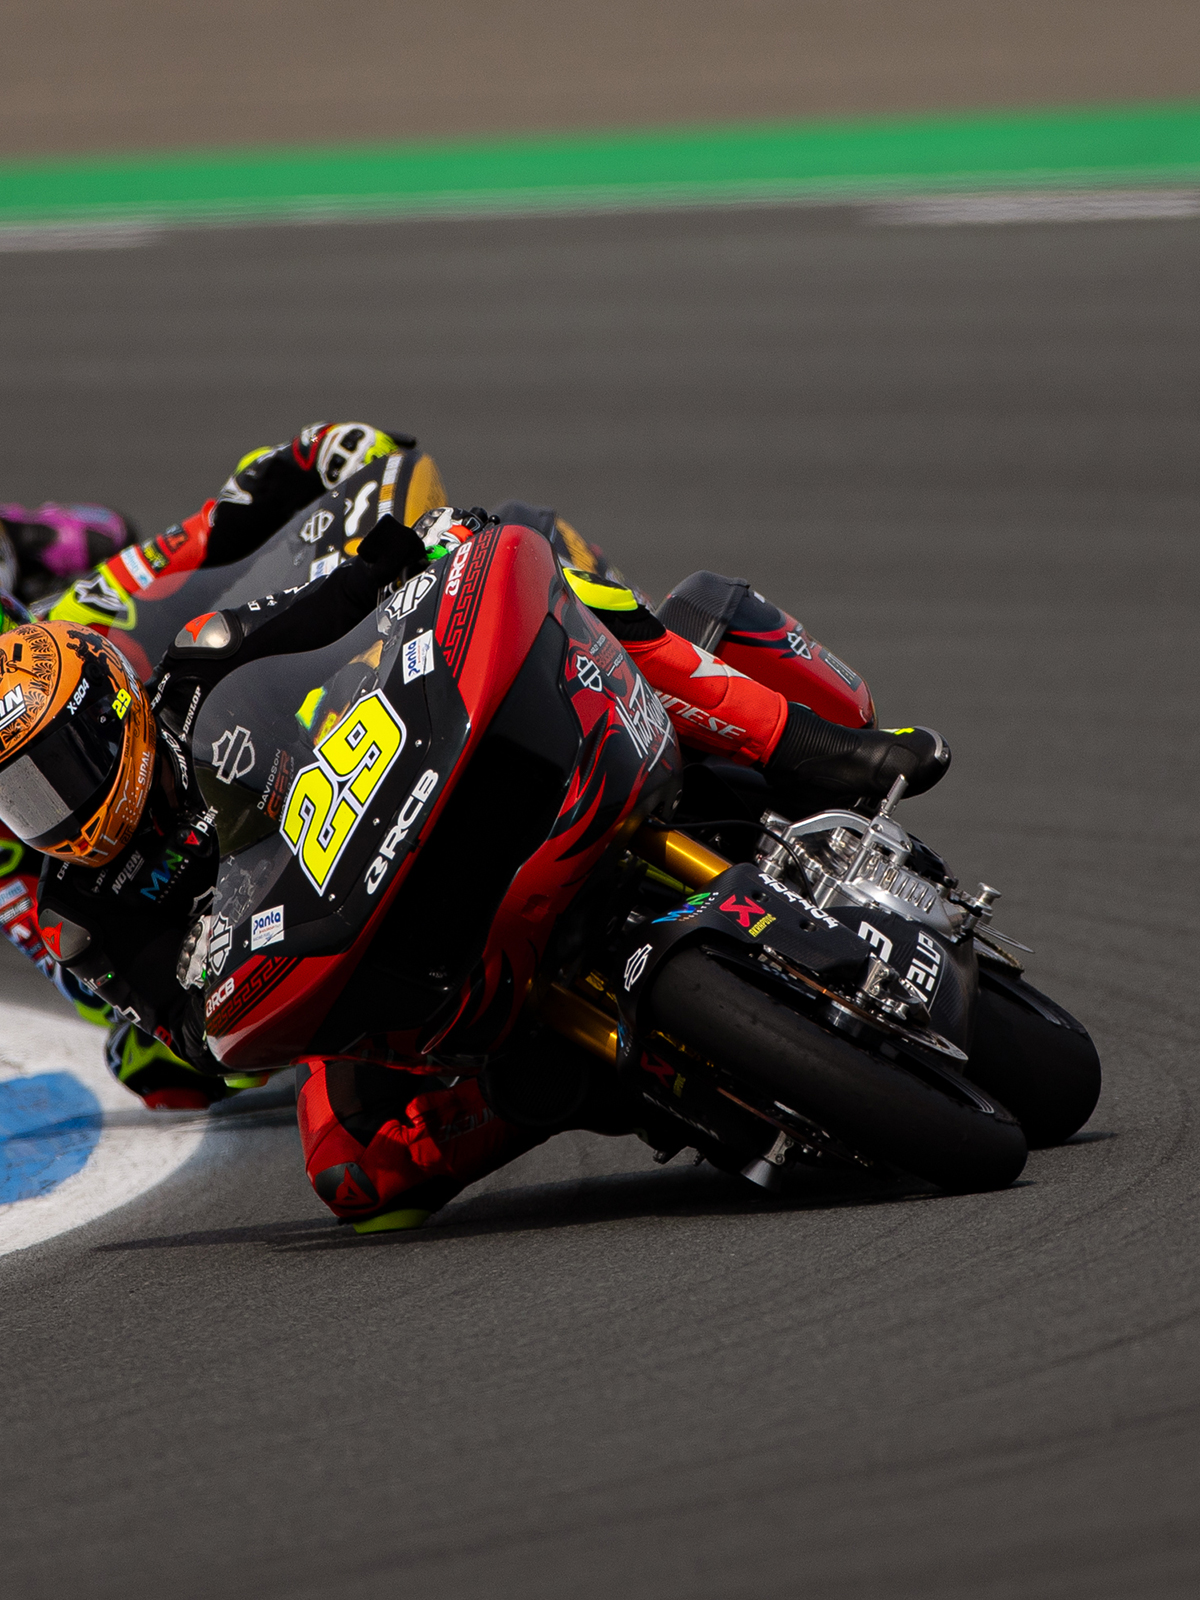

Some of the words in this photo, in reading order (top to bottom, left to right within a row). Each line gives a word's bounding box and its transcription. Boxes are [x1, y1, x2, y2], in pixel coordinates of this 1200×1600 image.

[111, 688, 131, 720] 29
[182, 685, 202, 733] DUNLOP
[136, 751, 152, 786] SIPAL
[257, 748, 282, 810] DAVIDSON
[279, 689, 407, 896] 29
[111, 850, 145, 895] NOLAN
[253, 911, 281, 936] panta
